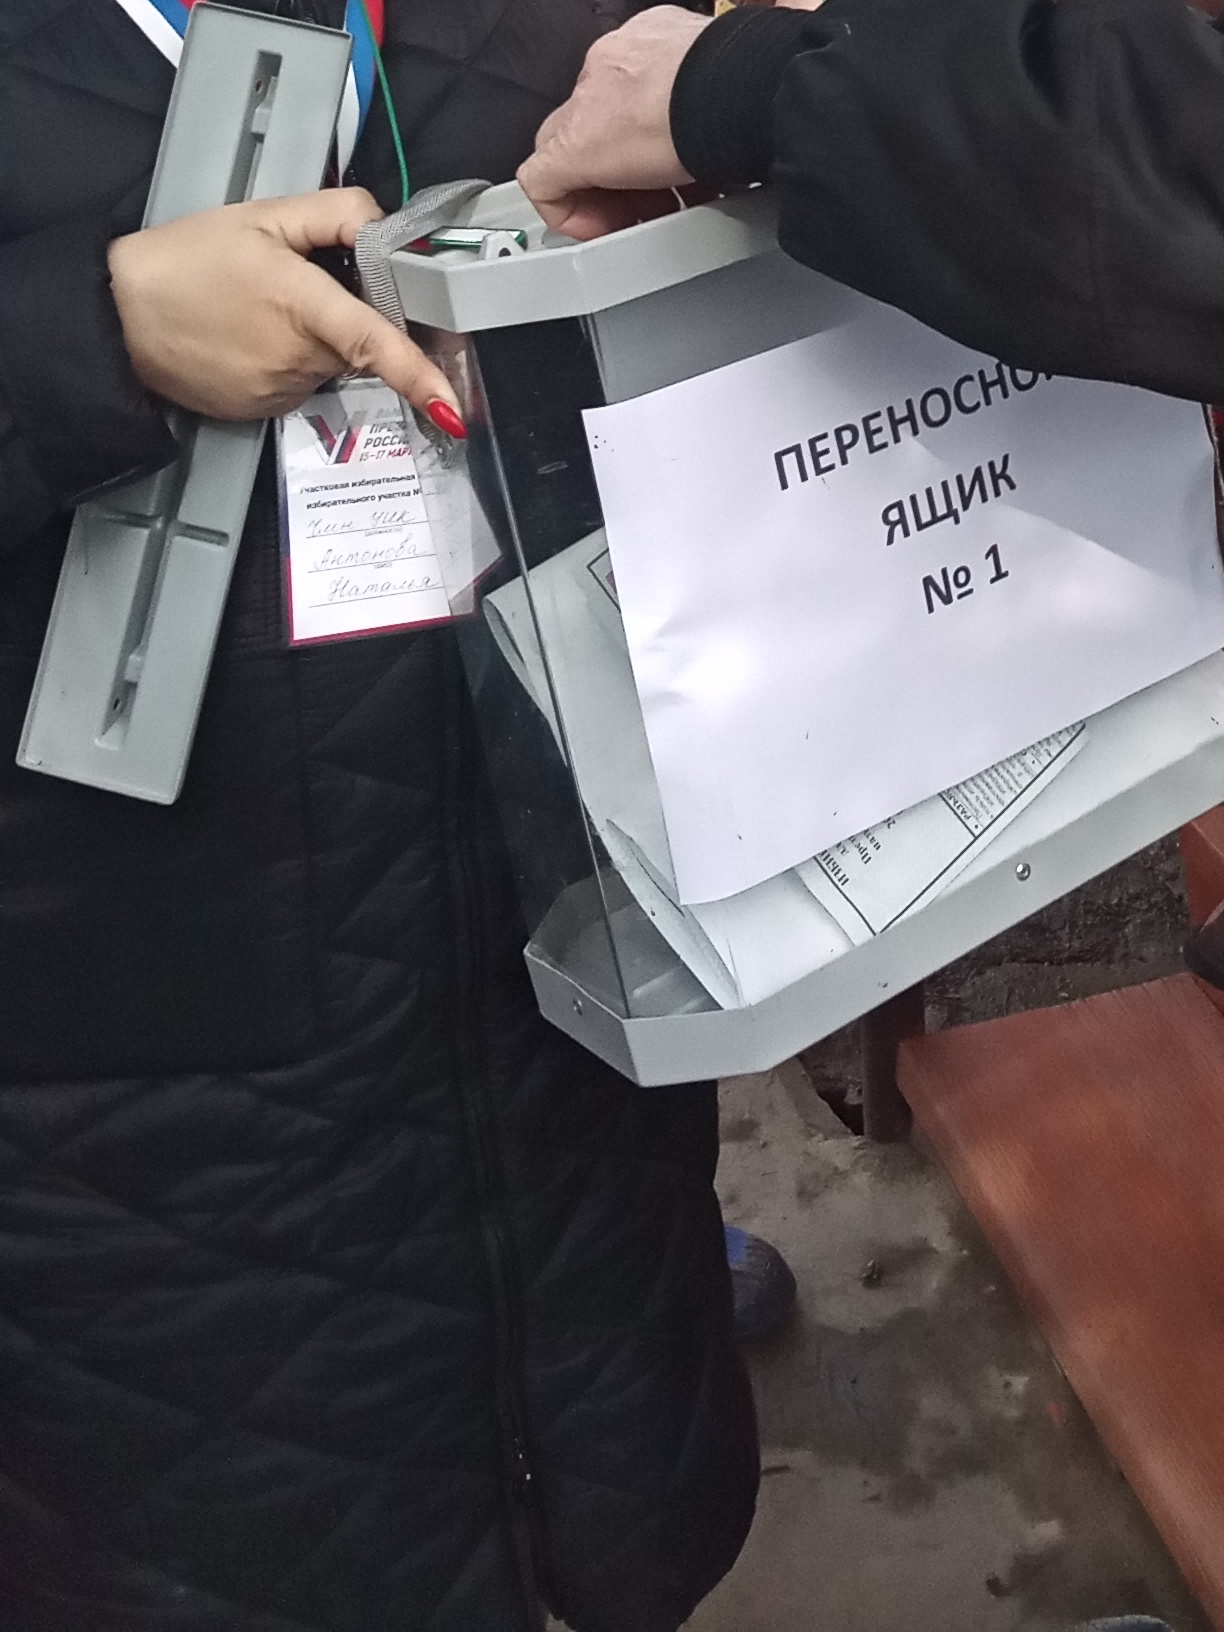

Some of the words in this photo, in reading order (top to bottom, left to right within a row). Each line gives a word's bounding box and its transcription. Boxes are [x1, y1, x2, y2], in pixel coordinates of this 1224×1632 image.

[773, 362, 1052, 492] ПЕРЕНОСНО
[306, 494, 377, 509] избирательного
[377, 489, 412, 503] участка
[351, 474, 416, 488] избирательная
[881, 453, 1017, 546] ЯЩИК
[327, 575, 439, 602] Наталья
[921, 566, 974, 615] №
[984, 543, 1010, 584] 1
